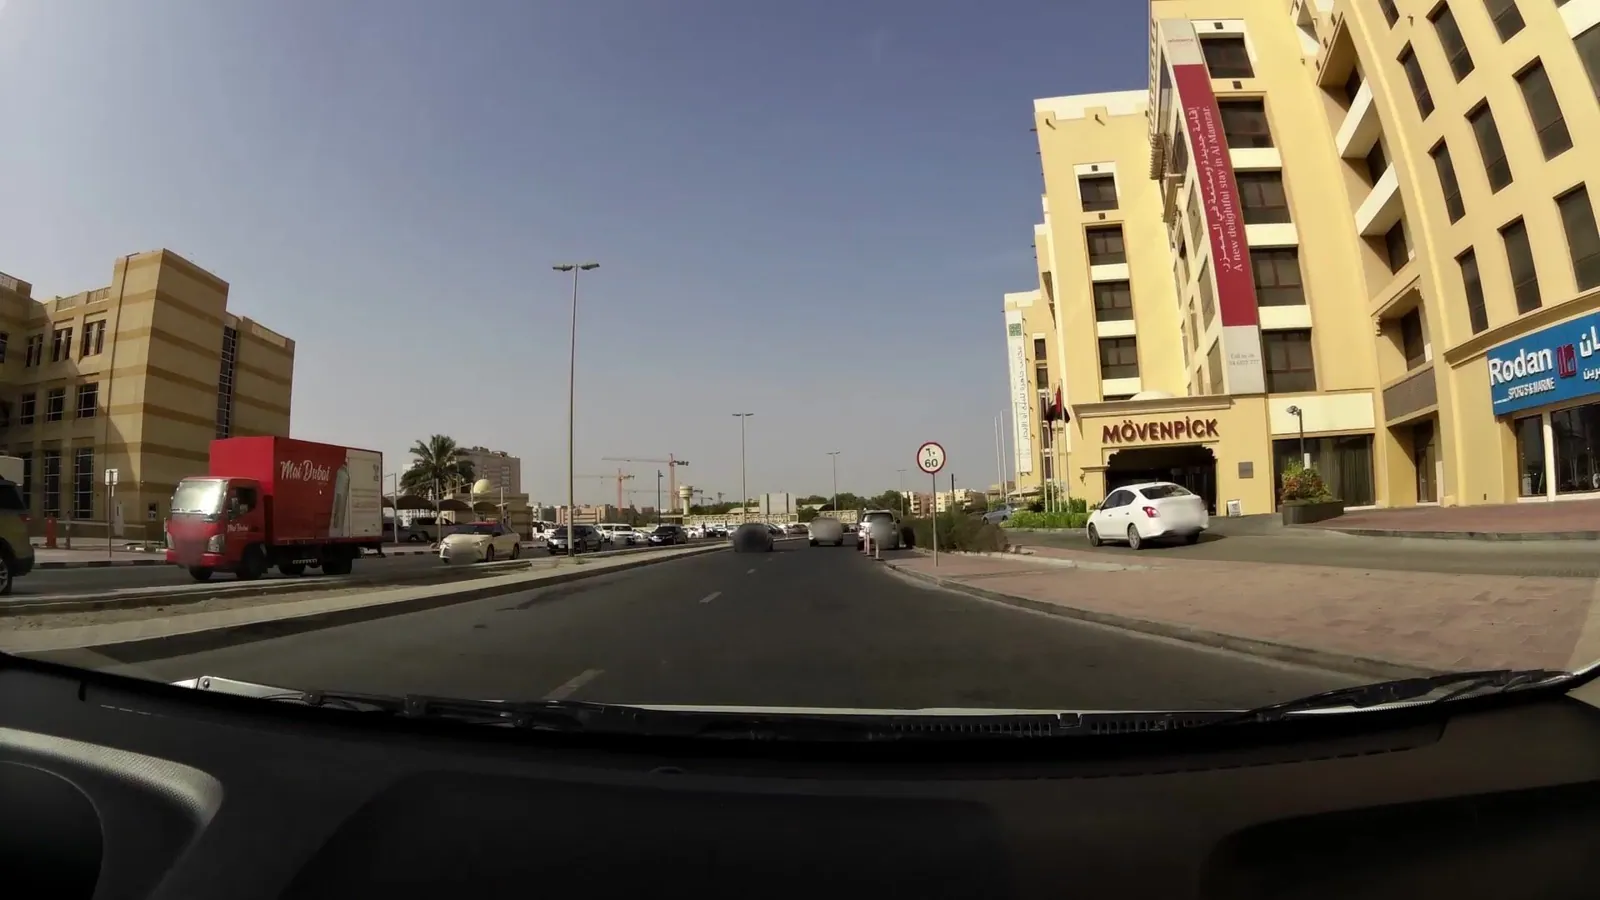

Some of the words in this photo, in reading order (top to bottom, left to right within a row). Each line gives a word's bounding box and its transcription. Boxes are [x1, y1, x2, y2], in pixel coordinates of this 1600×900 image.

[1210, 145, 1220, 156] Al
[1215, 158, 1223, 167] in
[1218, 169, 1228, 188] stay
[1210, 206, 1225, 221] في
[1220, 191, 1237, 238] delightful
[1231, 240, 1241, 261] new
[1233, 264, 1243, 272] A
[1488, 348, 1553, 386] Rodan
[280, 460, 302, 480] Mai
[303, 460, 330, 481] Dubai
[924, 459, 938, 468] 60
